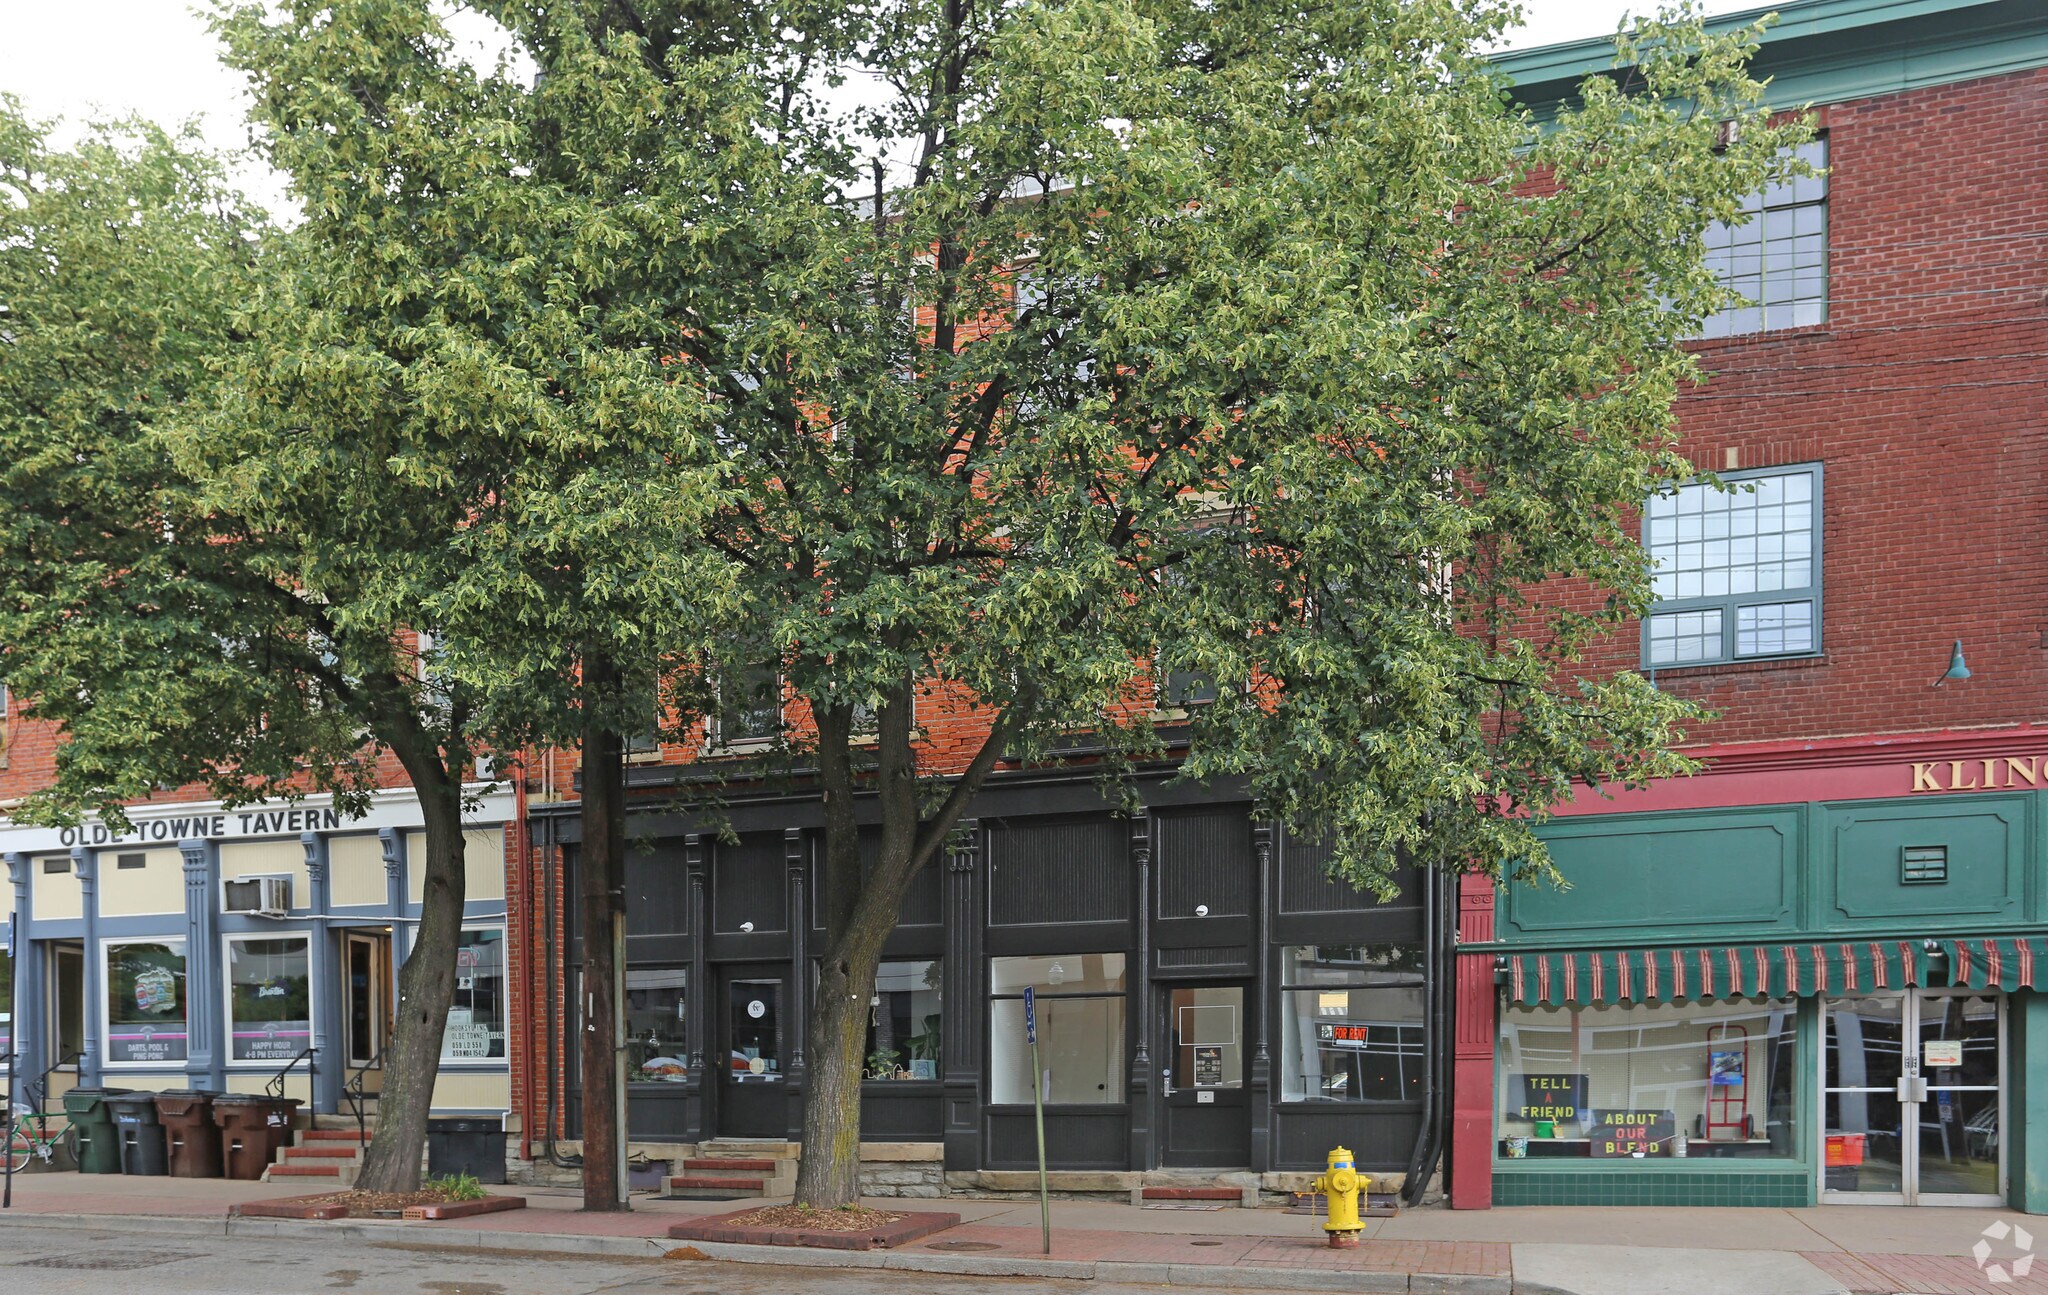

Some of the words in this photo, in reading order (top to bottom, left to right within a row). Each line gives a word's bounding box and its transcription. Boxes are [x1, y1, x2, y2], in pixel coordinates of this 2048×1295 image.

[1909, 756, 2048, 792] KLIN
[136, 815, 225, 841] TOWNE
[238, 808, 340, 834] TAVERN
[1334, 1027, 1347, 1039] FOR
[1348, 1027, 1366, 1040] RENT
[252, 1041, 273, 1049] HAPPY
[273, 1041, 291, 1049] HOUR
[133, 1052, 147, 1060] PING
[147, 1052, 164, 1060] PONG
[267, 1050, 298, 1058] EVERYDAY
[1530, 1078, 1571, 1089] TELL
[1544, 1092, 1552, 1103] A
[1520, 1106, 1574, 1118] FRIEND
[1605, 1113, 1657, 1125] ABOUT
[1616, 1127, 1646, 1138] OUR
[1606, 1141, 1659, 1154] BLEND
